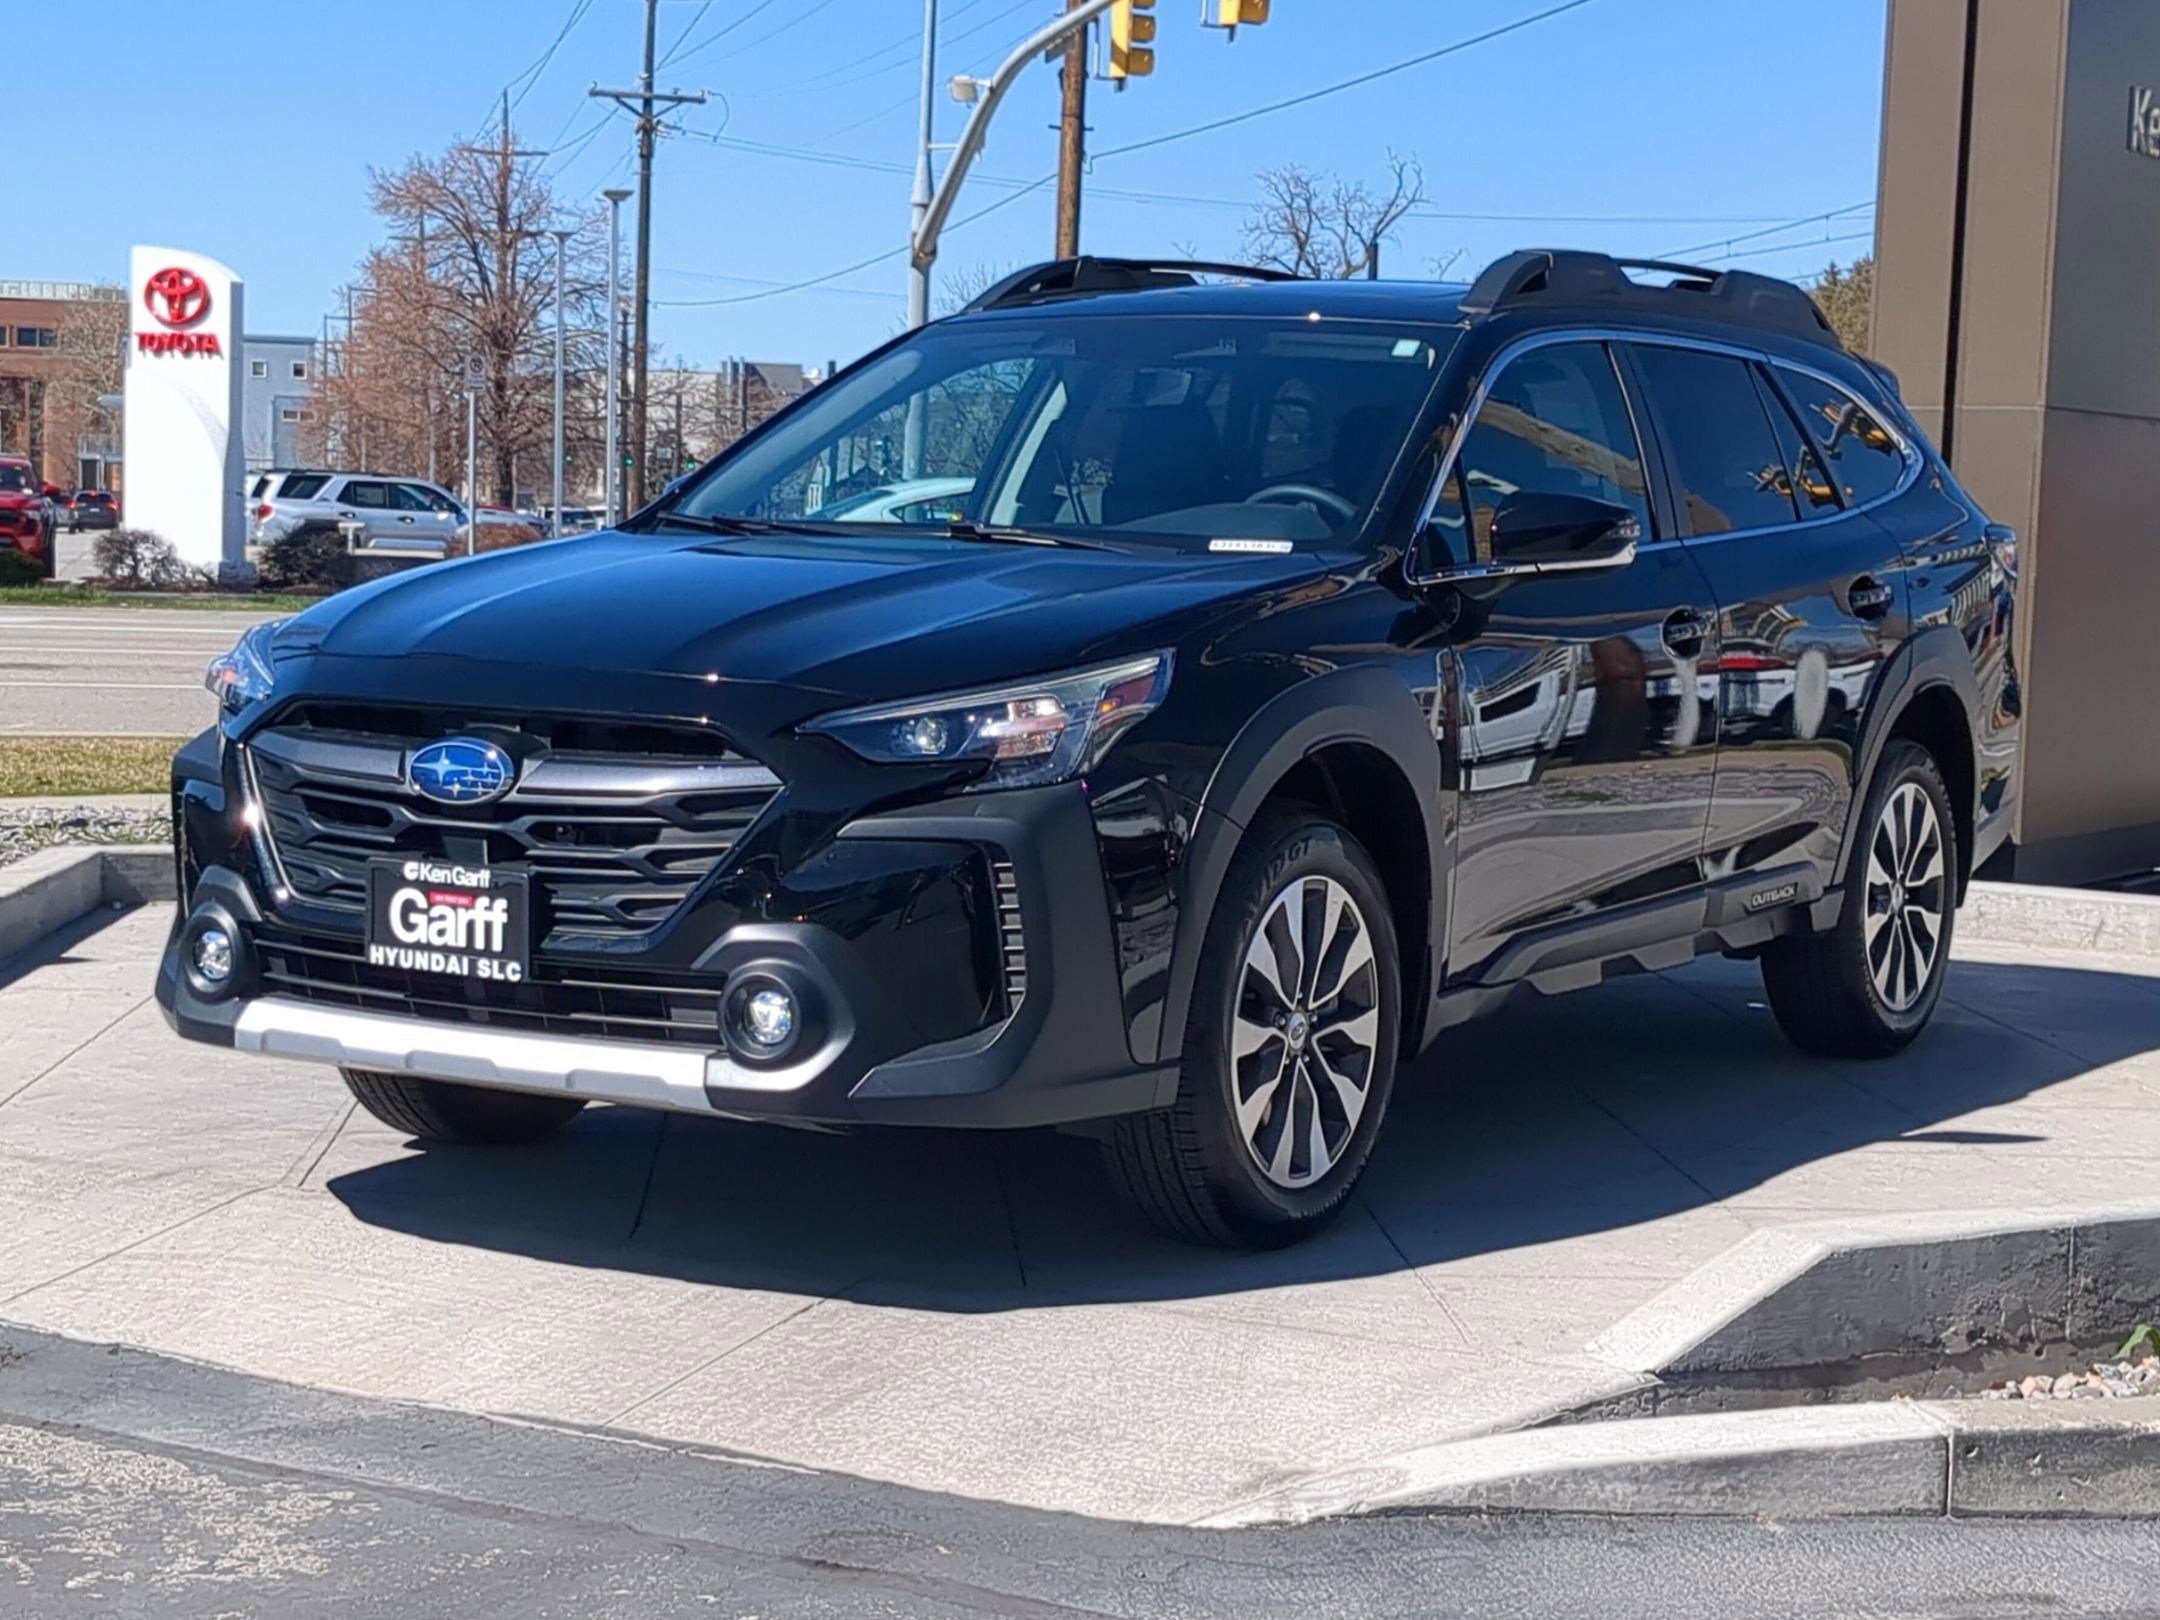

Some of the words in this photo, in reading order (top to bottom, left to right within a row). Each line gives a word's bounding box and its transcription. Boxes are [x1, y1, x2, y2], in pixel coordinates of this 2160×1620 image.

[134, 331, 220, 355] TOYOTA
[420, 863, 451, 883] Ken
[452, 866, 491, 888] Garff
[1752, 885, 1795, 907] OUTBACK
[389, 887, 508, 952] Garff
[369, 943, 470, 976] HYUNDAI
[477, 958, 522, 982] SLC
